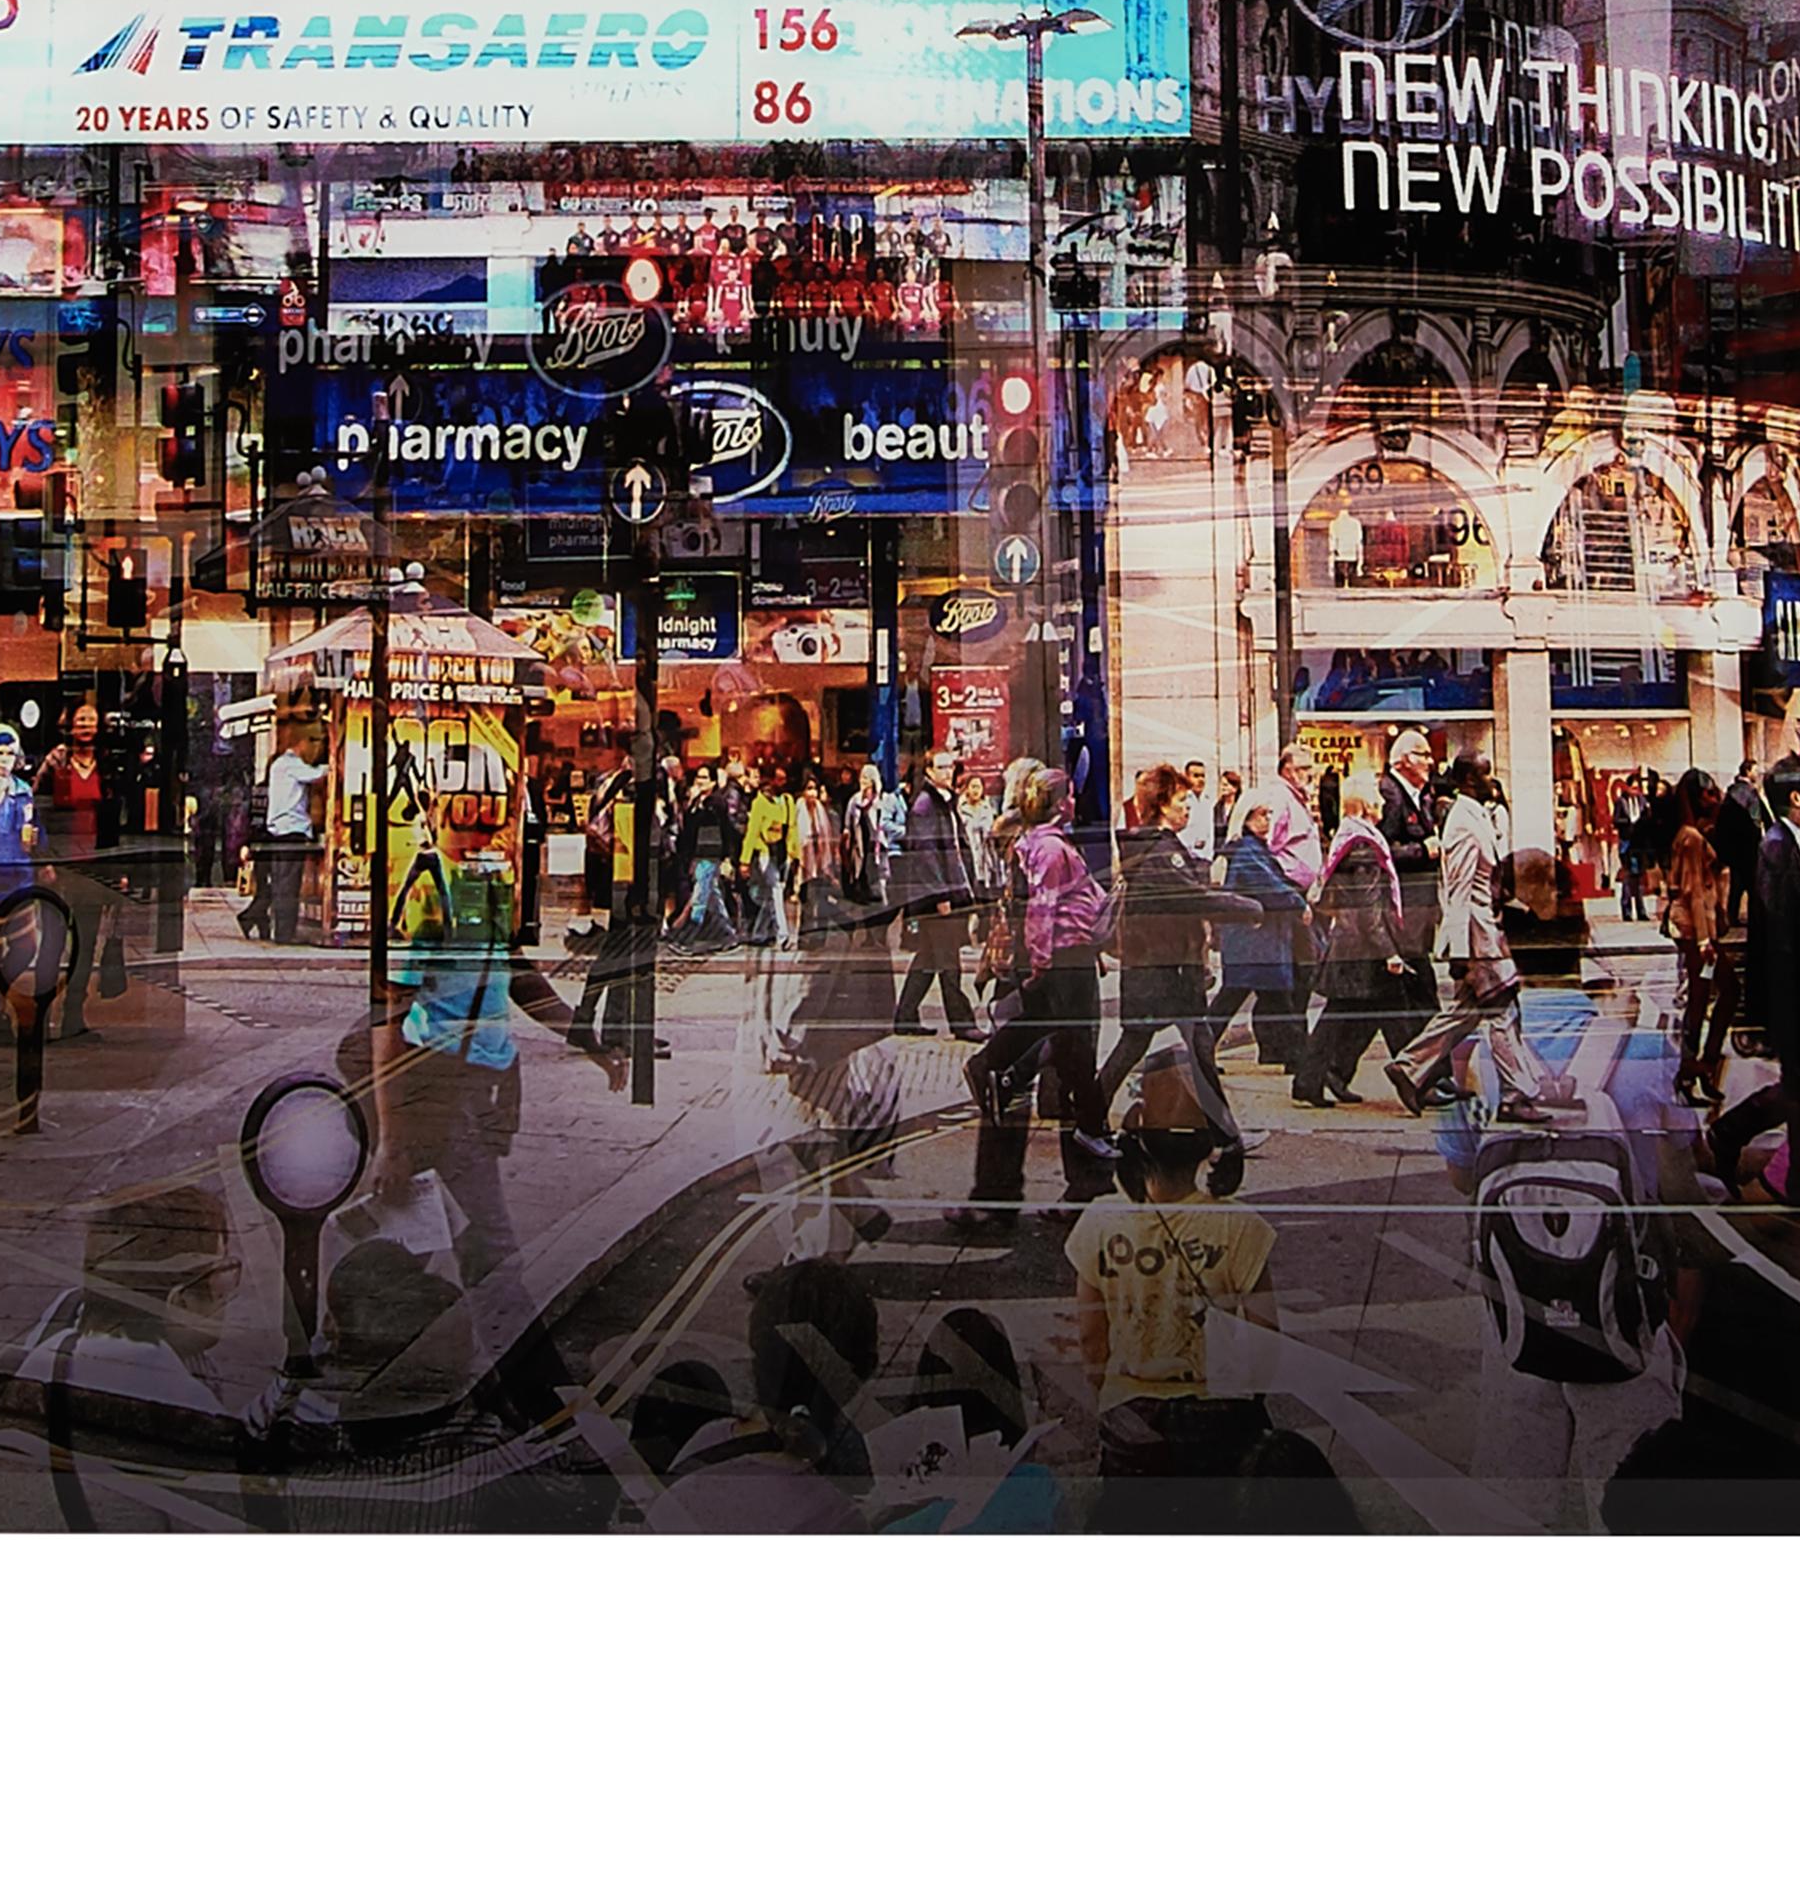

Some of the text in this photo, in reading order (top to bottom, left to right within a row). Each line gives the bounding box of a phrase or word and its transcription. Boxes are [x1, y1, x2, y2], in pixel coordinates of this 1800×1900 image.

[178, 9, 709, 71] TRANSAERO
[753, 7, 839, 52] 156
[752, 79, 813, 126] 86
[1340, 50, 1506, 127] NEW
[75, 103, 536, 132] 20 YEARS OF SAFETY & QUALITY
[1343, 139, 1508, 214] NEW
[546, 306, 648, 370] Boots
[843, 412, 990, 462] beaut
[288, 515, 369, 551] ROCK
[657, 616, 717, 635] idnight
[936, 597, 999, 635] Boots
[388, 653, 424, 682] WILL
[479, 656, 515, 684] YOU
[390, 681, 440, 701] PRICE
[936, 686, 951, 708] 3
[964, 685, 978, 707] 2
[439, 793, 509, 828] YOU
